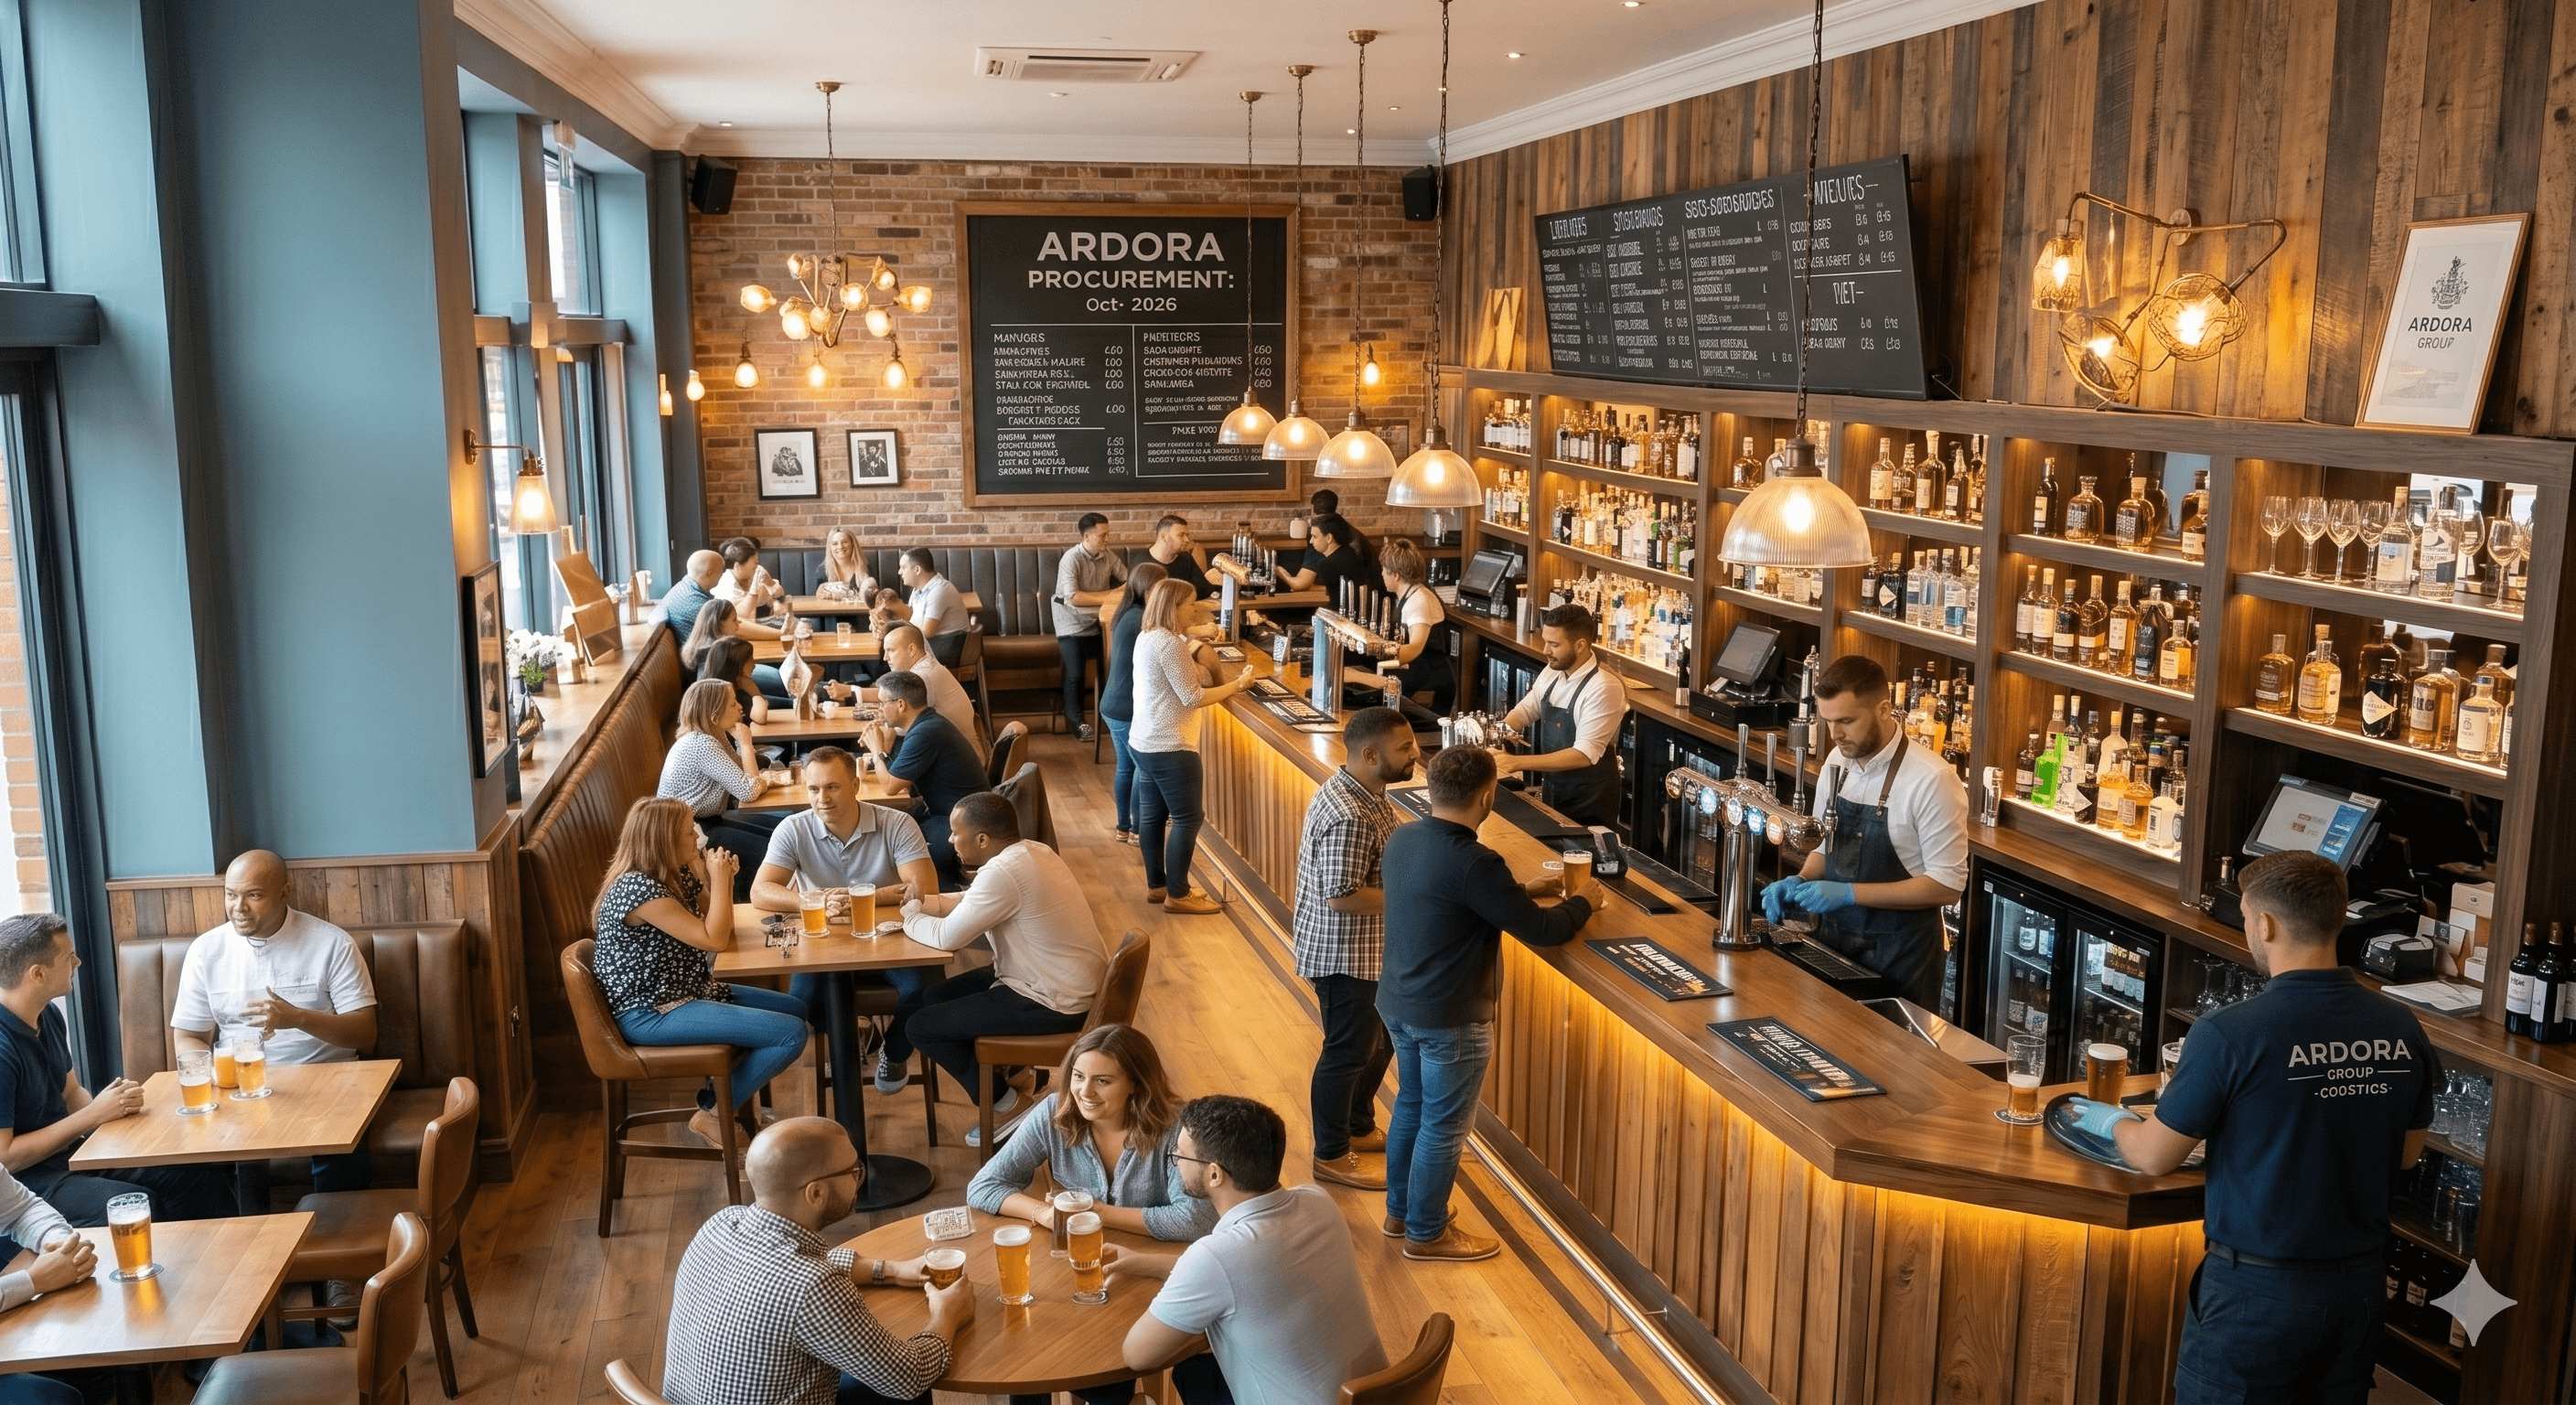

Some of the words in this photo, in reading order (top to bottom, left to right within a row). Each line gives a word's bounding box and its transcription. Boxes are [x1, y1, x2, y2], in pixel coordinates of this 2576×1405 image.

[1037, 231, 1225, 262] ARDORA
[1028, 271, 1234, 288] PROCUREMENT:
[1132, 297, 1177, 312] 2026
[2408, 316, 2473, 332] ARDORA
[2417, 337, 2455, 349] GROUP
[2288, 1038, 2412, 1068] ARDORA
[2327, 1067, 2375, 1080] GROUP
